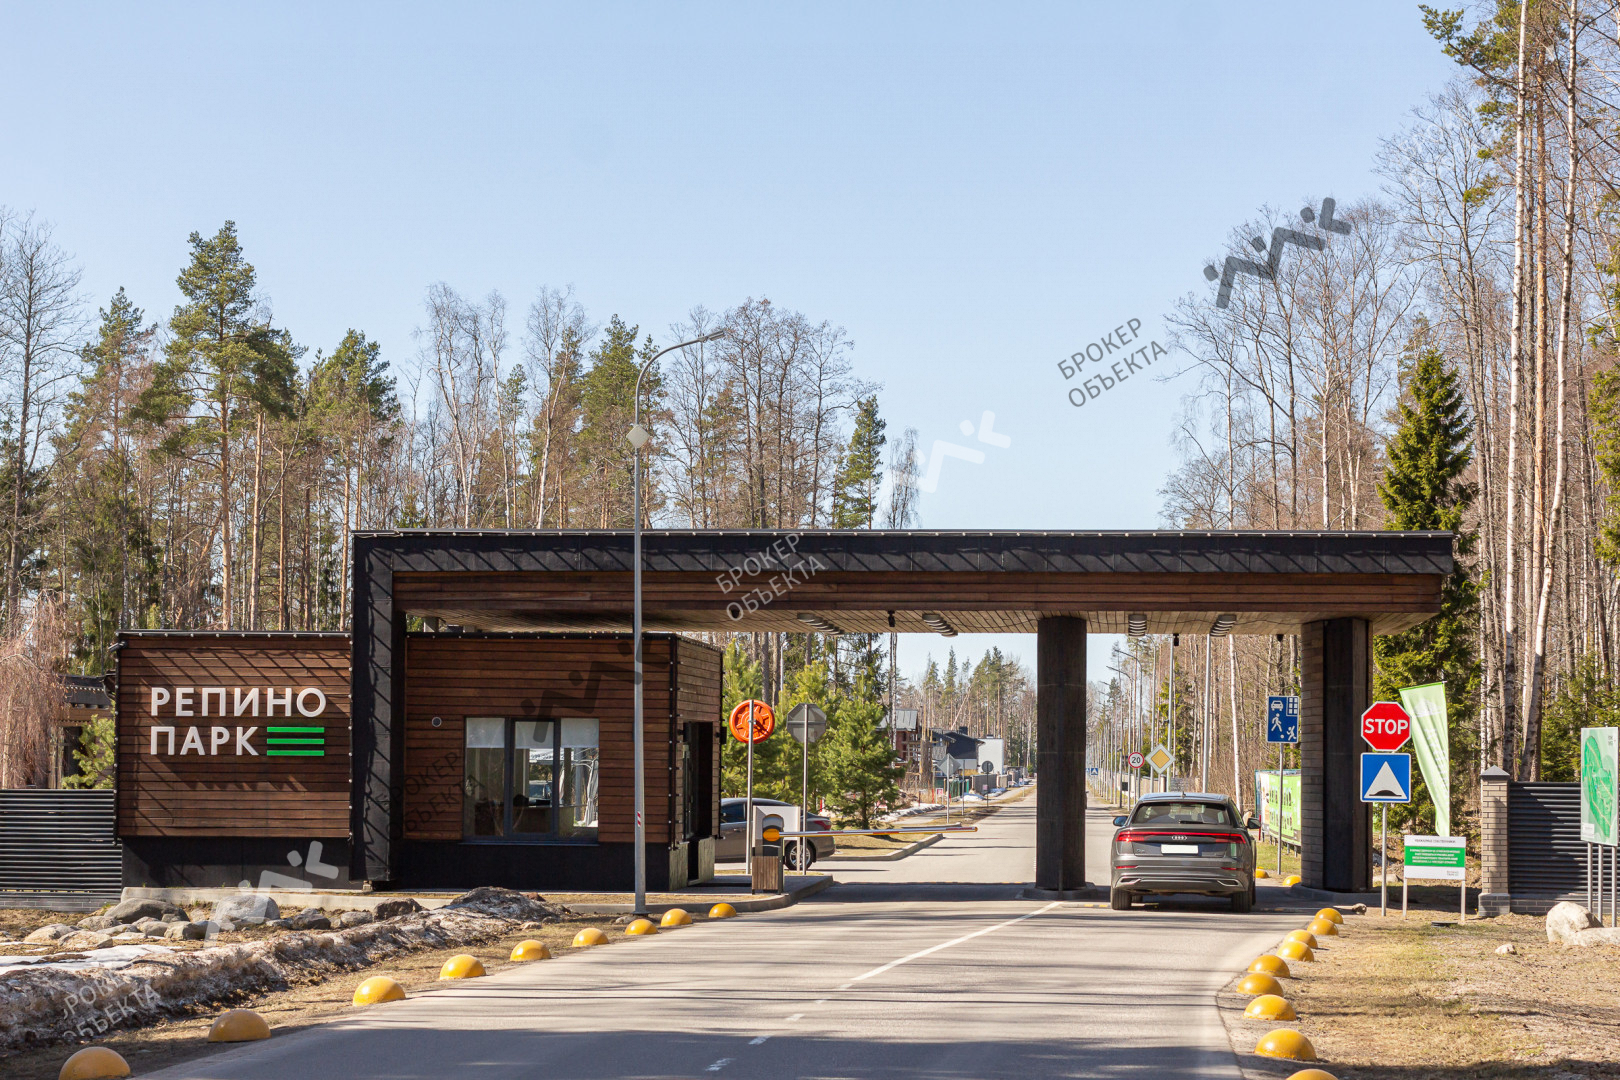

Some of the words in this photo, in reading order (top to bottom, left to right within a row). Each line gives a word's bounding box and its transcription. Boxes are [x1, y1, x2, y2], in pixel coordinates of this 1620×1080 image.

[150, 687, 327, 718] РЕПИНО
[1364, 718, 1409, 735] STOP
[150, 726, 260, 756] ПАРК
[1131, 756, 1141, 764] 20
